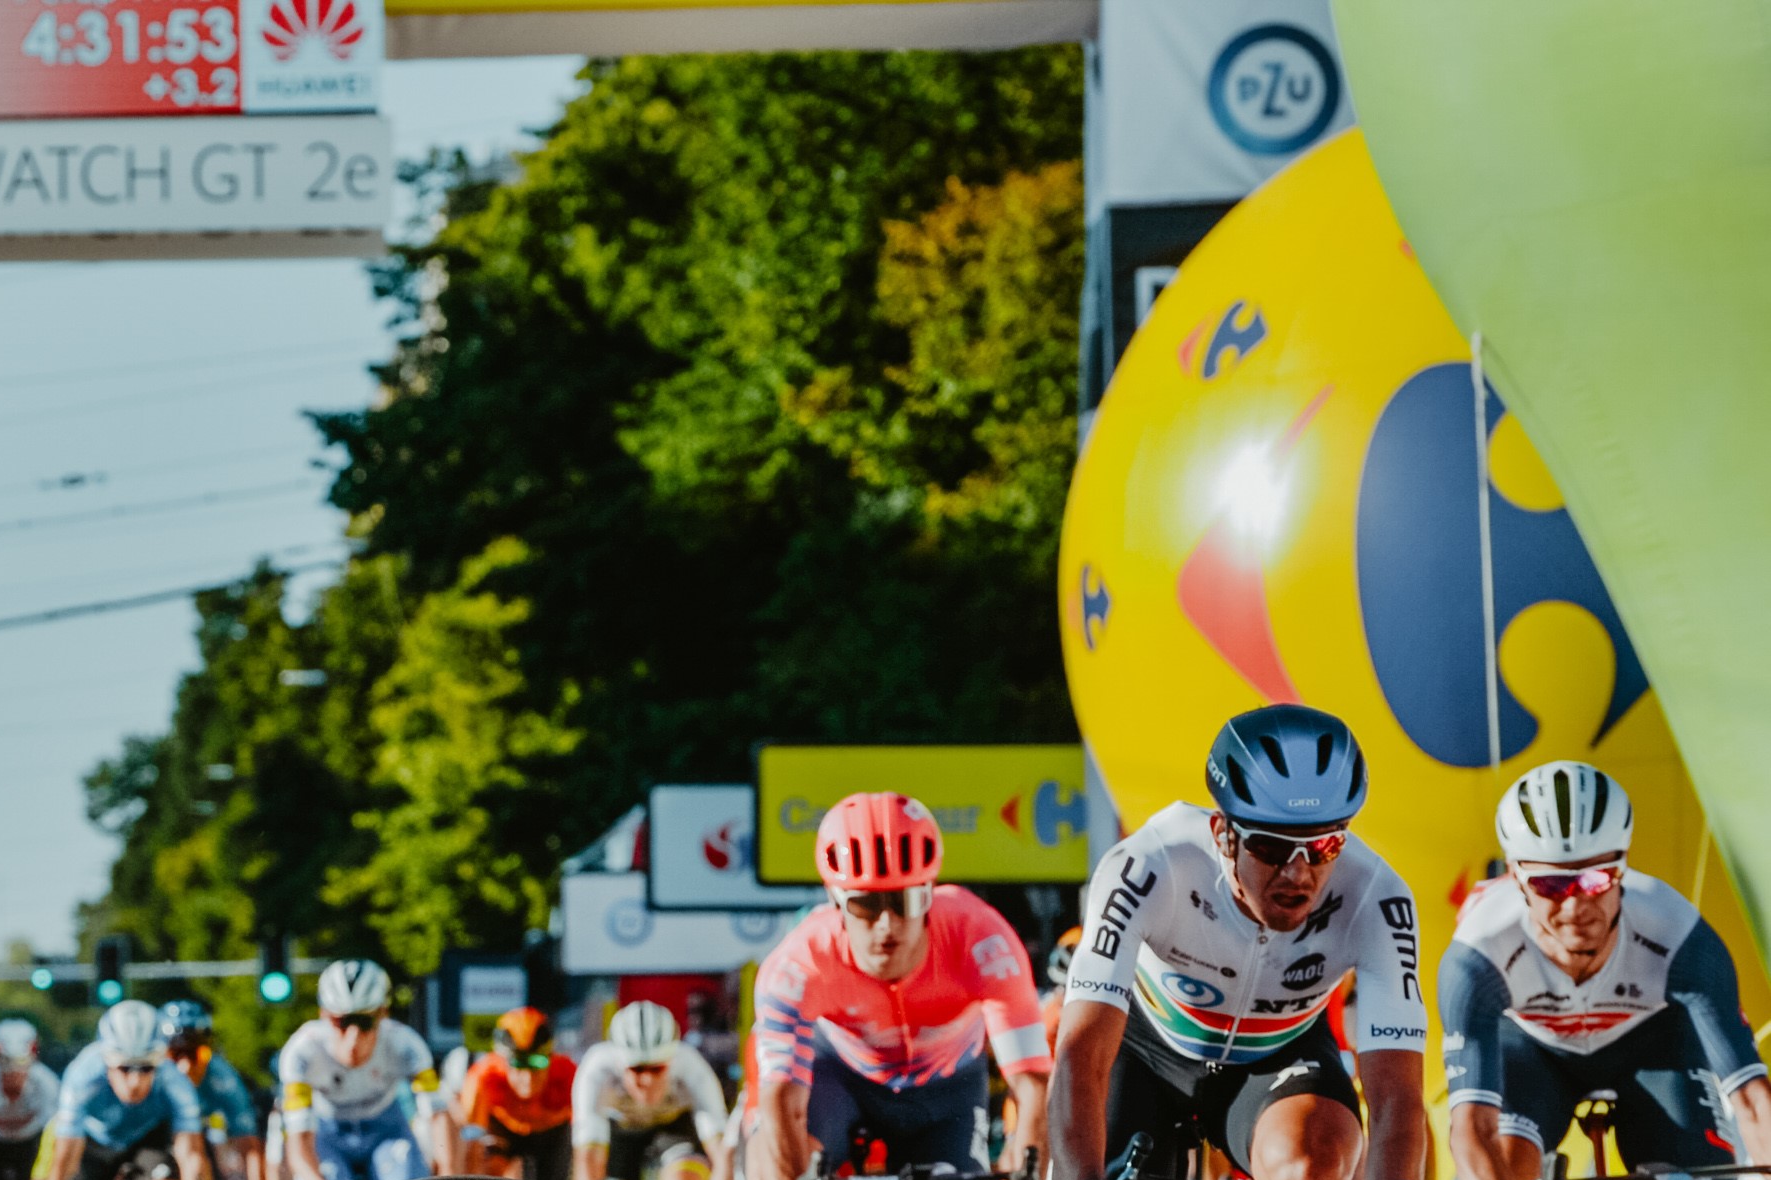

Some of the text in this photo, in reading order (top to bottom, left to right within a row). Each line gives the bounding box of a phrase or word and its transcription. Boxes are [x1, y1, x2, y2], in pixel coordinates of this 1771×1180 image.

[22, 7, 237, 66] 4:31:53
[143, 67, 237, 107] +3.2
[1238, 63, 1312, 117] PZU
[191, 143, 279, 202] GT
[305, 141, 379, 201] 2e
[1287, 797, 1320, 808] GIRO
[1091, 856, 1157, 961] BMC
[1379, 896, 1424, 1004] BMC
